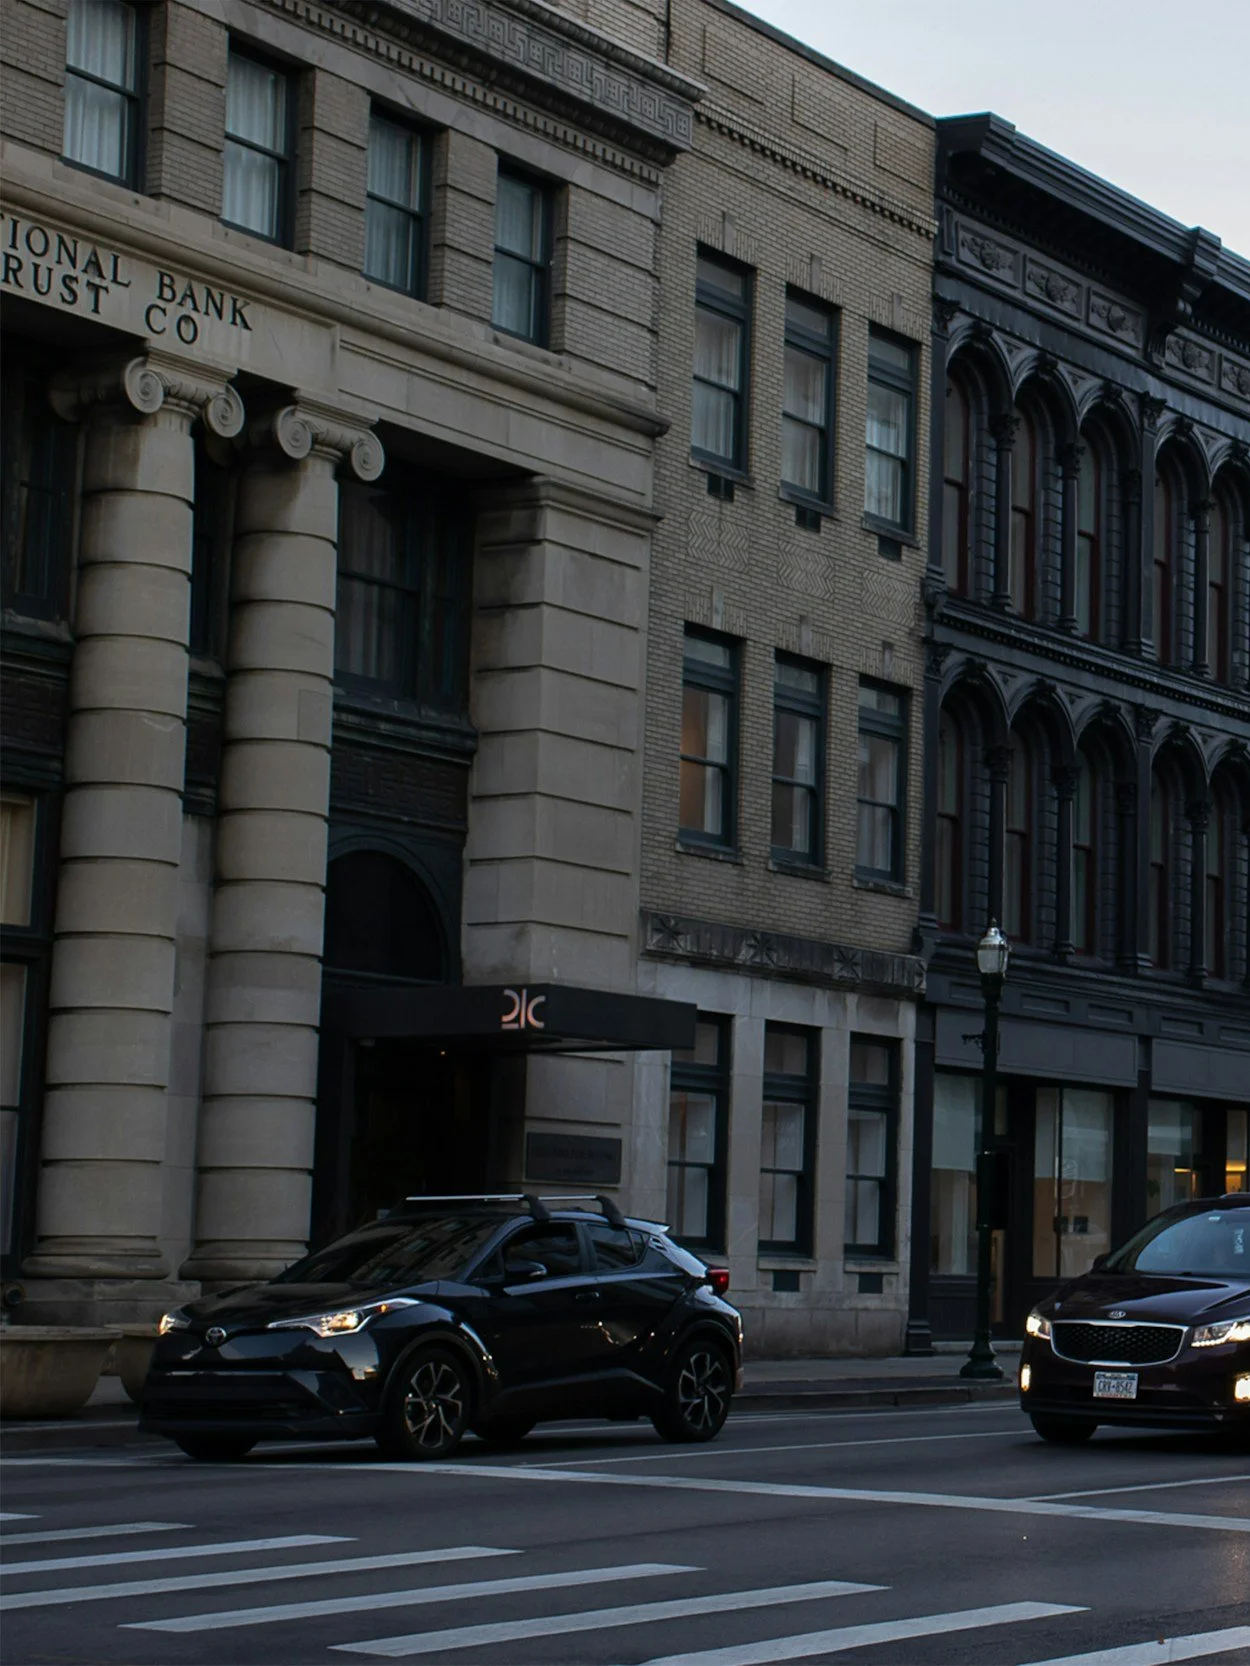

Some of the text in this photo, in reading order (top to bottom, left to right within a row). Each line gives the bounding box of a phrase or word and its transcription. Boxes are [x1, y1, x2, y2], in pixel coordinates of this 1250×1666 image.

[0, 213, 252, 331] IONAL BANK
[1, 252, 199, 345] RUST CO
